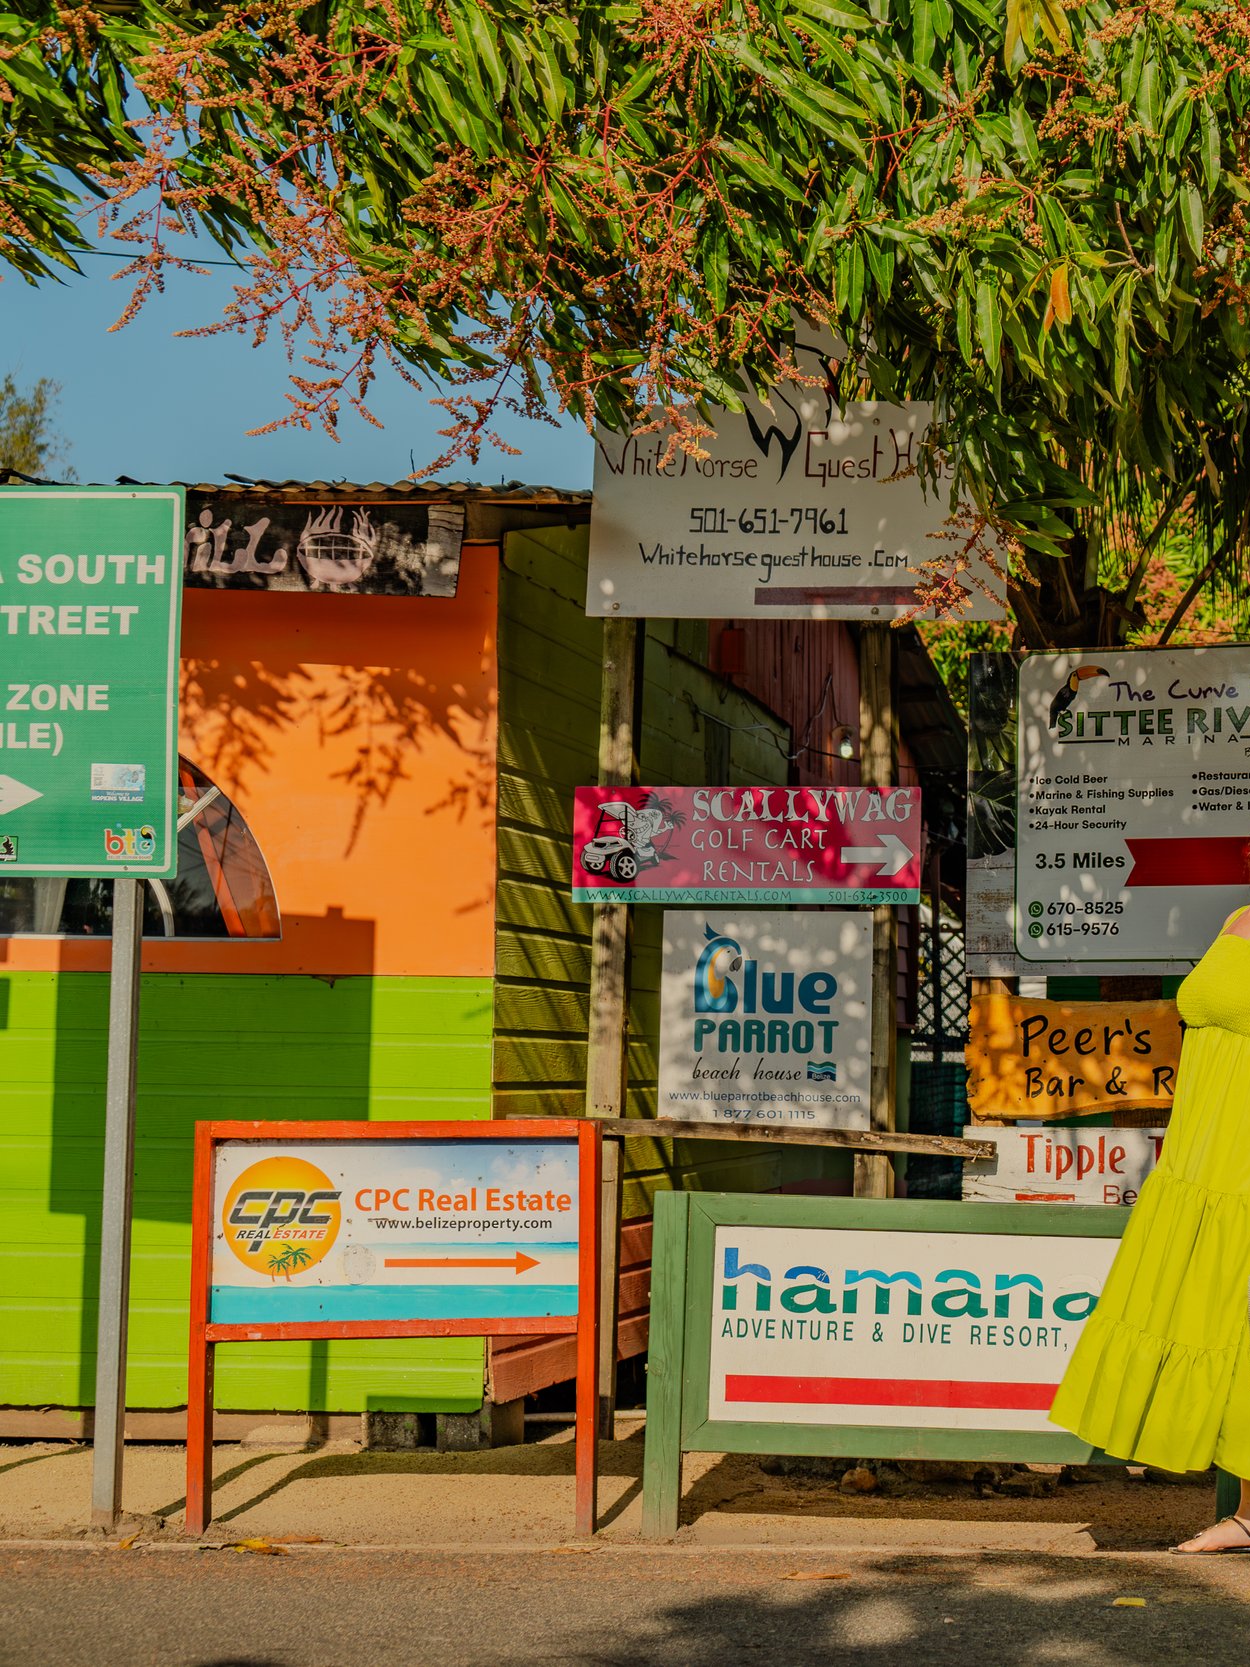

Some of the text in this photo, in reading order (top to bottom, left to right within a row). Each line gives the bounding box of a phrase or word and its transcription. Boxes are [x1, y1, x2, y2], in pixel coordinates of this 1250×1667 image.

[688, 507, 849, 534] 501-651-7961
[17, 553, 165, 585] SOUTH
[0, 605, 139, 635] TREET
[6, 683, 109, 711] ZONE
[1108, 681, 1156, 702] The
[1167, 679, 1240, 700] Curve
[1058, 707, 1174, 738] SITTEE
[0, 722, 64, 757] ILE)
[1118, 733, 1239, 747] MARINA
[1035, 774, 1108, 785] Ice Cold Beer
[691, 788, 916, 824] SCALLYWAG
[1035, 787, 1174, 801] Marine & Fishing Supplies
[1198, 801, 1233, 811] Water
[1235, 801, 1243, 811] &
[1035, 804, 1106, 817] Kayak Rental
[1035, 819, 1128, 831] 24-Hour Security
[690, 828, 828, 852] GOLF CART
[703, 860, 816, 883] RENTALS
[1035, 852, 1125, 869] 3.5 Miles
[1047, 901, 1124, 916] 670-8525
[1046, 922, 1120, 936] 615-9576
[694, 930, 838, 1014] Blue
[693, 1018, 840, 1054] PARROT
[1019, 1013, 1153, 1058] Peer's
[692, 1057, 741, 1081] beach
[752, 1057, 803, 1081] house
[1025, 1065, 1085, 1099] Bar
[1105, 1065, 1128, 1096] &
[668, 1091, 861, 1103] www.blueparrotbeachhouse.com
[723, 1109, 752, 1119] 877
[756, 1110, 783, 1119] 601
[1019, 1133, 1127, 1182] Tipple
[354, 1186, 572, 1213] CPC Real Estate
[235, 1228, 327, 1241] REAL ESTATE
[374, 1216, 553, 1233] www.belizeproperty.com
[721, 1317, 1069, 1352] ADVENTURE & DIVE RESORT,
